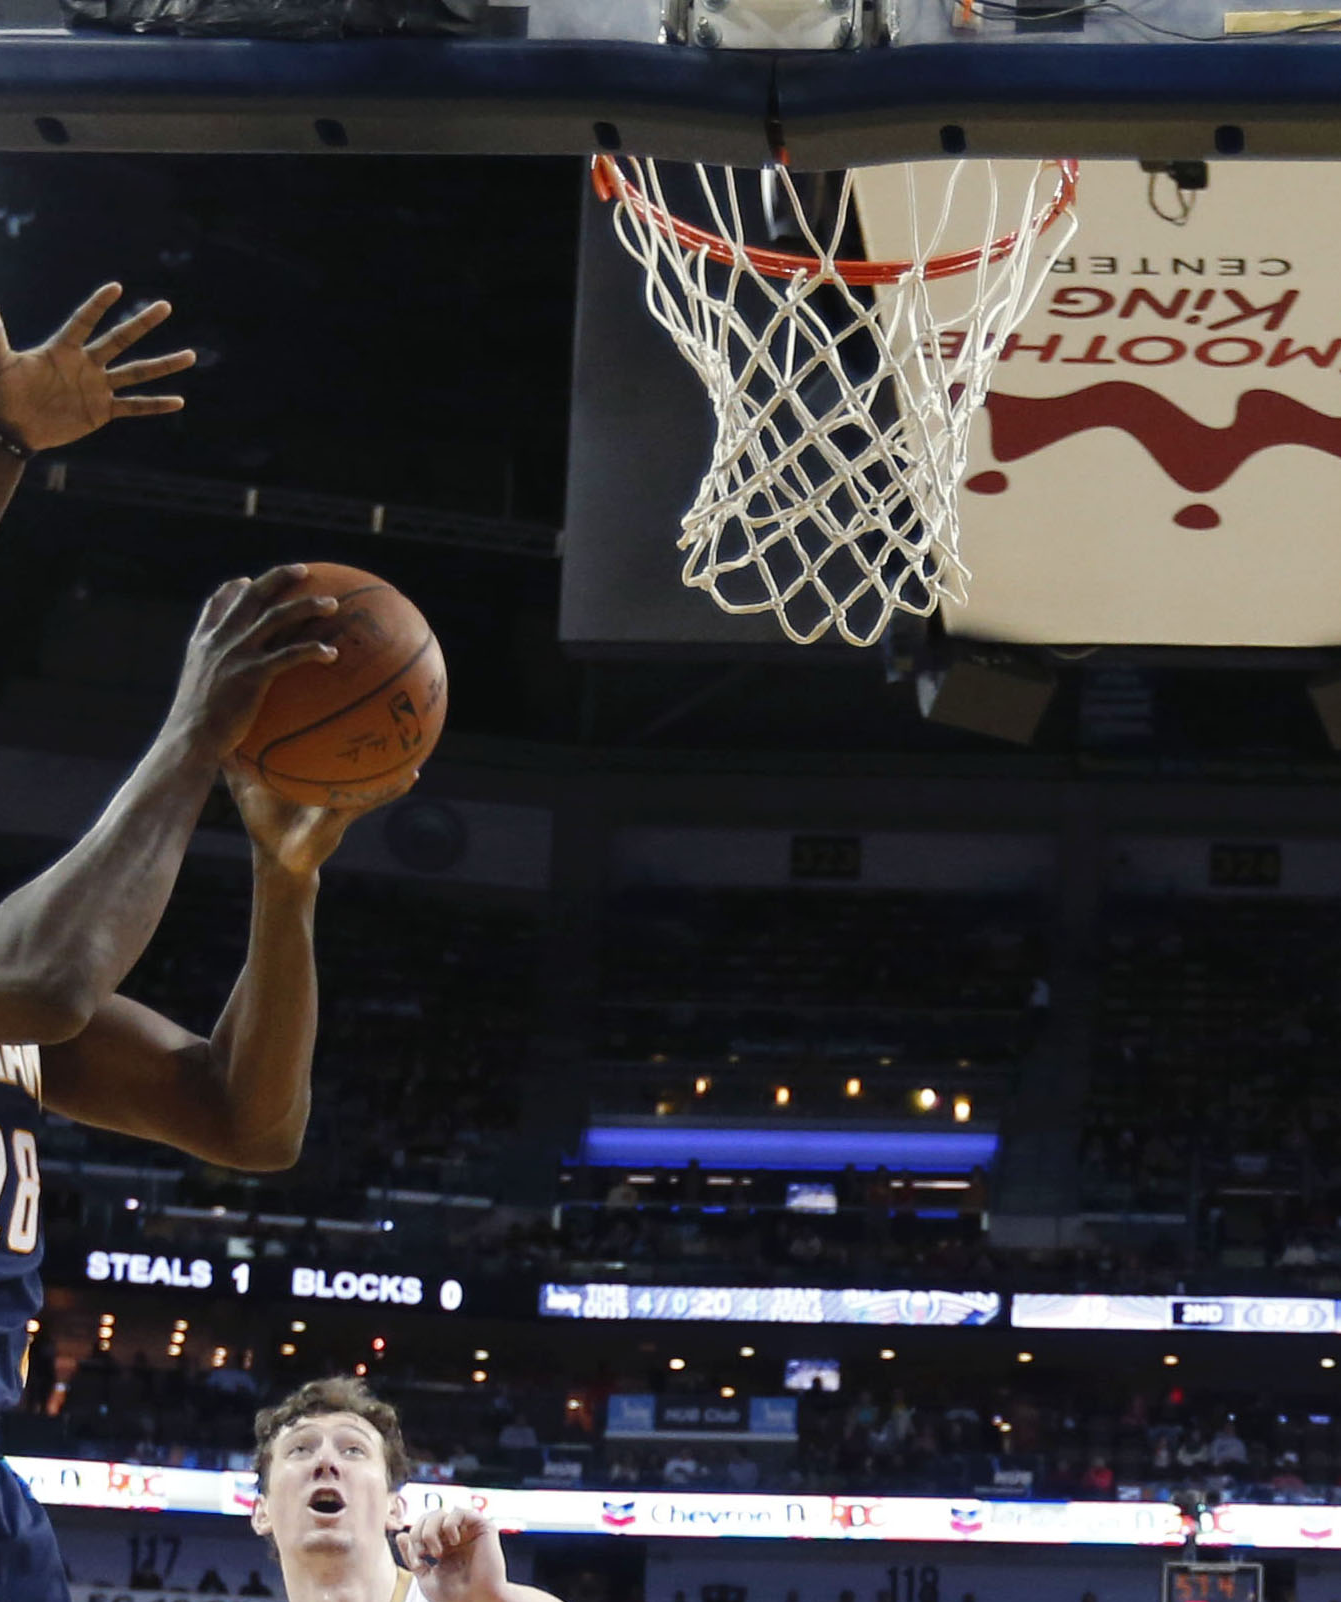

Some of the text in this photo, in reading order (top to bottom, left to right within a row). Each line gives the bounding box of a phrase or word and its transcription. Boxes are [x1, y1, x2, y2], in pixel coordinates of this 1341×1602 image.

[1044, 255, 1291, 277] CENTER
[86, 1250, 463, 1312] STEALS 1 BLOCKS 0
[1182, 1305, 1223, 1323] 2ND
[886, 1567, 940, 1602] 118
